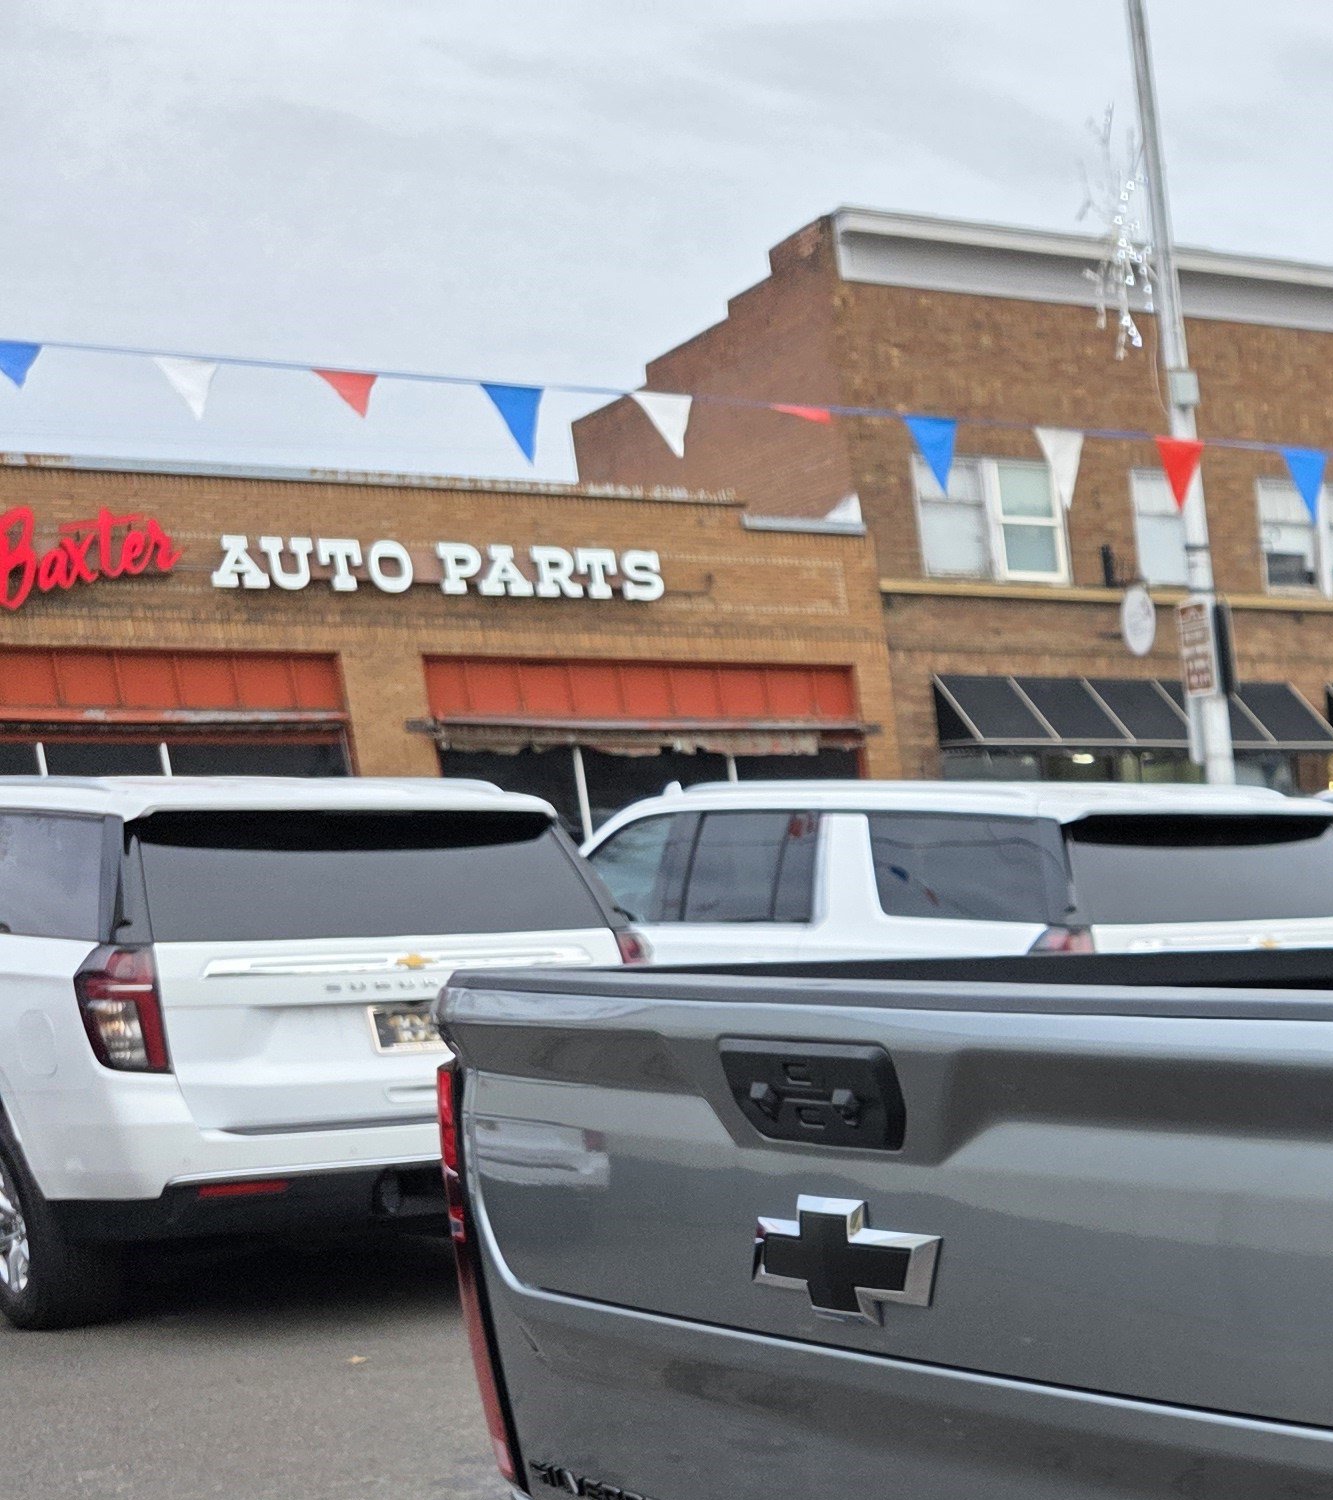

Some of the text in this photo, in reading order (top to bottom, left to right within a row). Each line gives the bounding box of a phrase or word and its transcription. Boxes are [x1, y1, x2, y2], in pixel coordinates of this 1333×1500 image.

[0, 506, 186, 611] Baxter
[211, 534, 665, 600] AUTO PARTS
